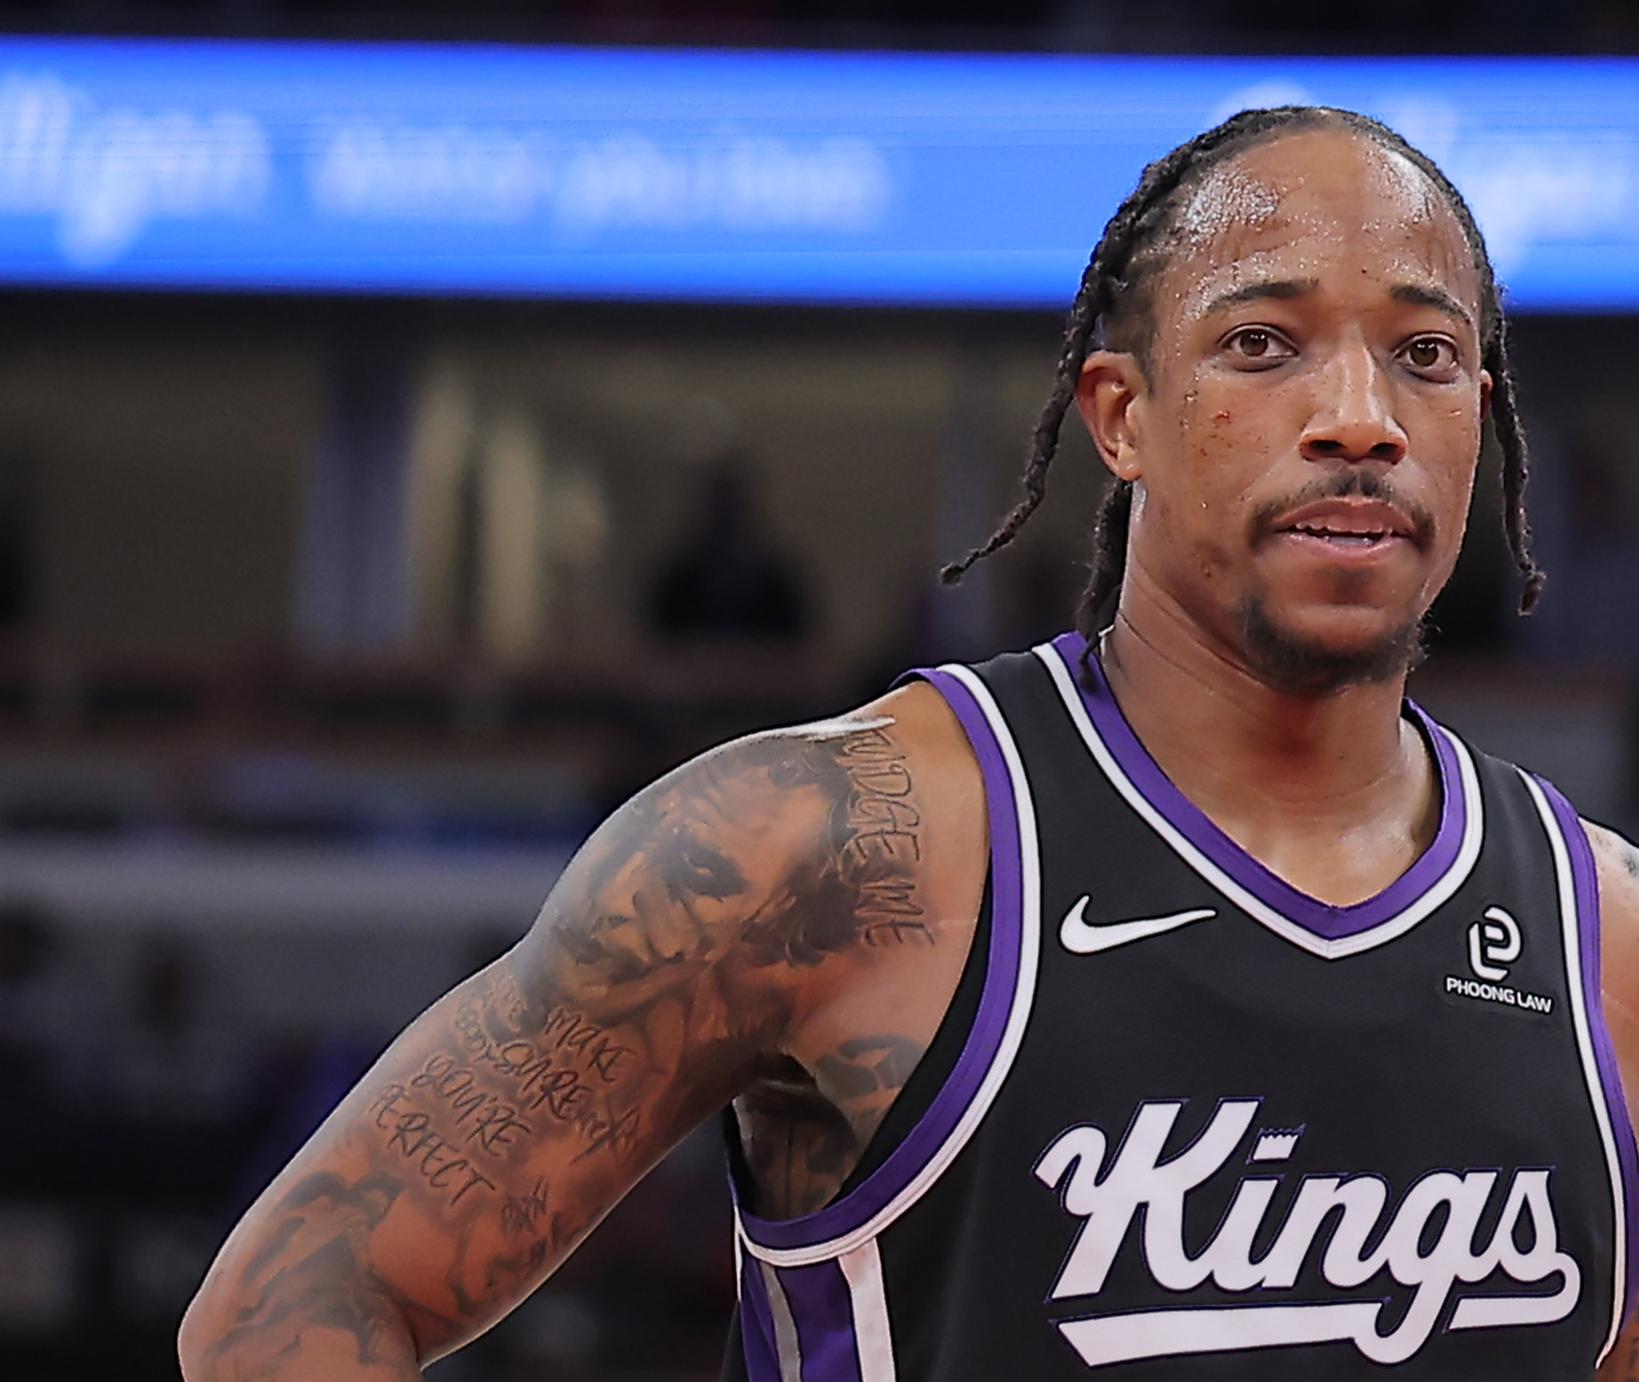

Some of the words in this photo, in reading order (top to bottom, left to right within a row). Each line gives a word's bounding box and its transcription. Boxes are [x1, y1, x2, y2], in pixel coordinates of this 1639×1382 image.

[1446, 977, 1515, 1004] PHOONG
[1517, 991, 1552, 1013] LAW
[1033, 1099, 1581, 1366] Kings
